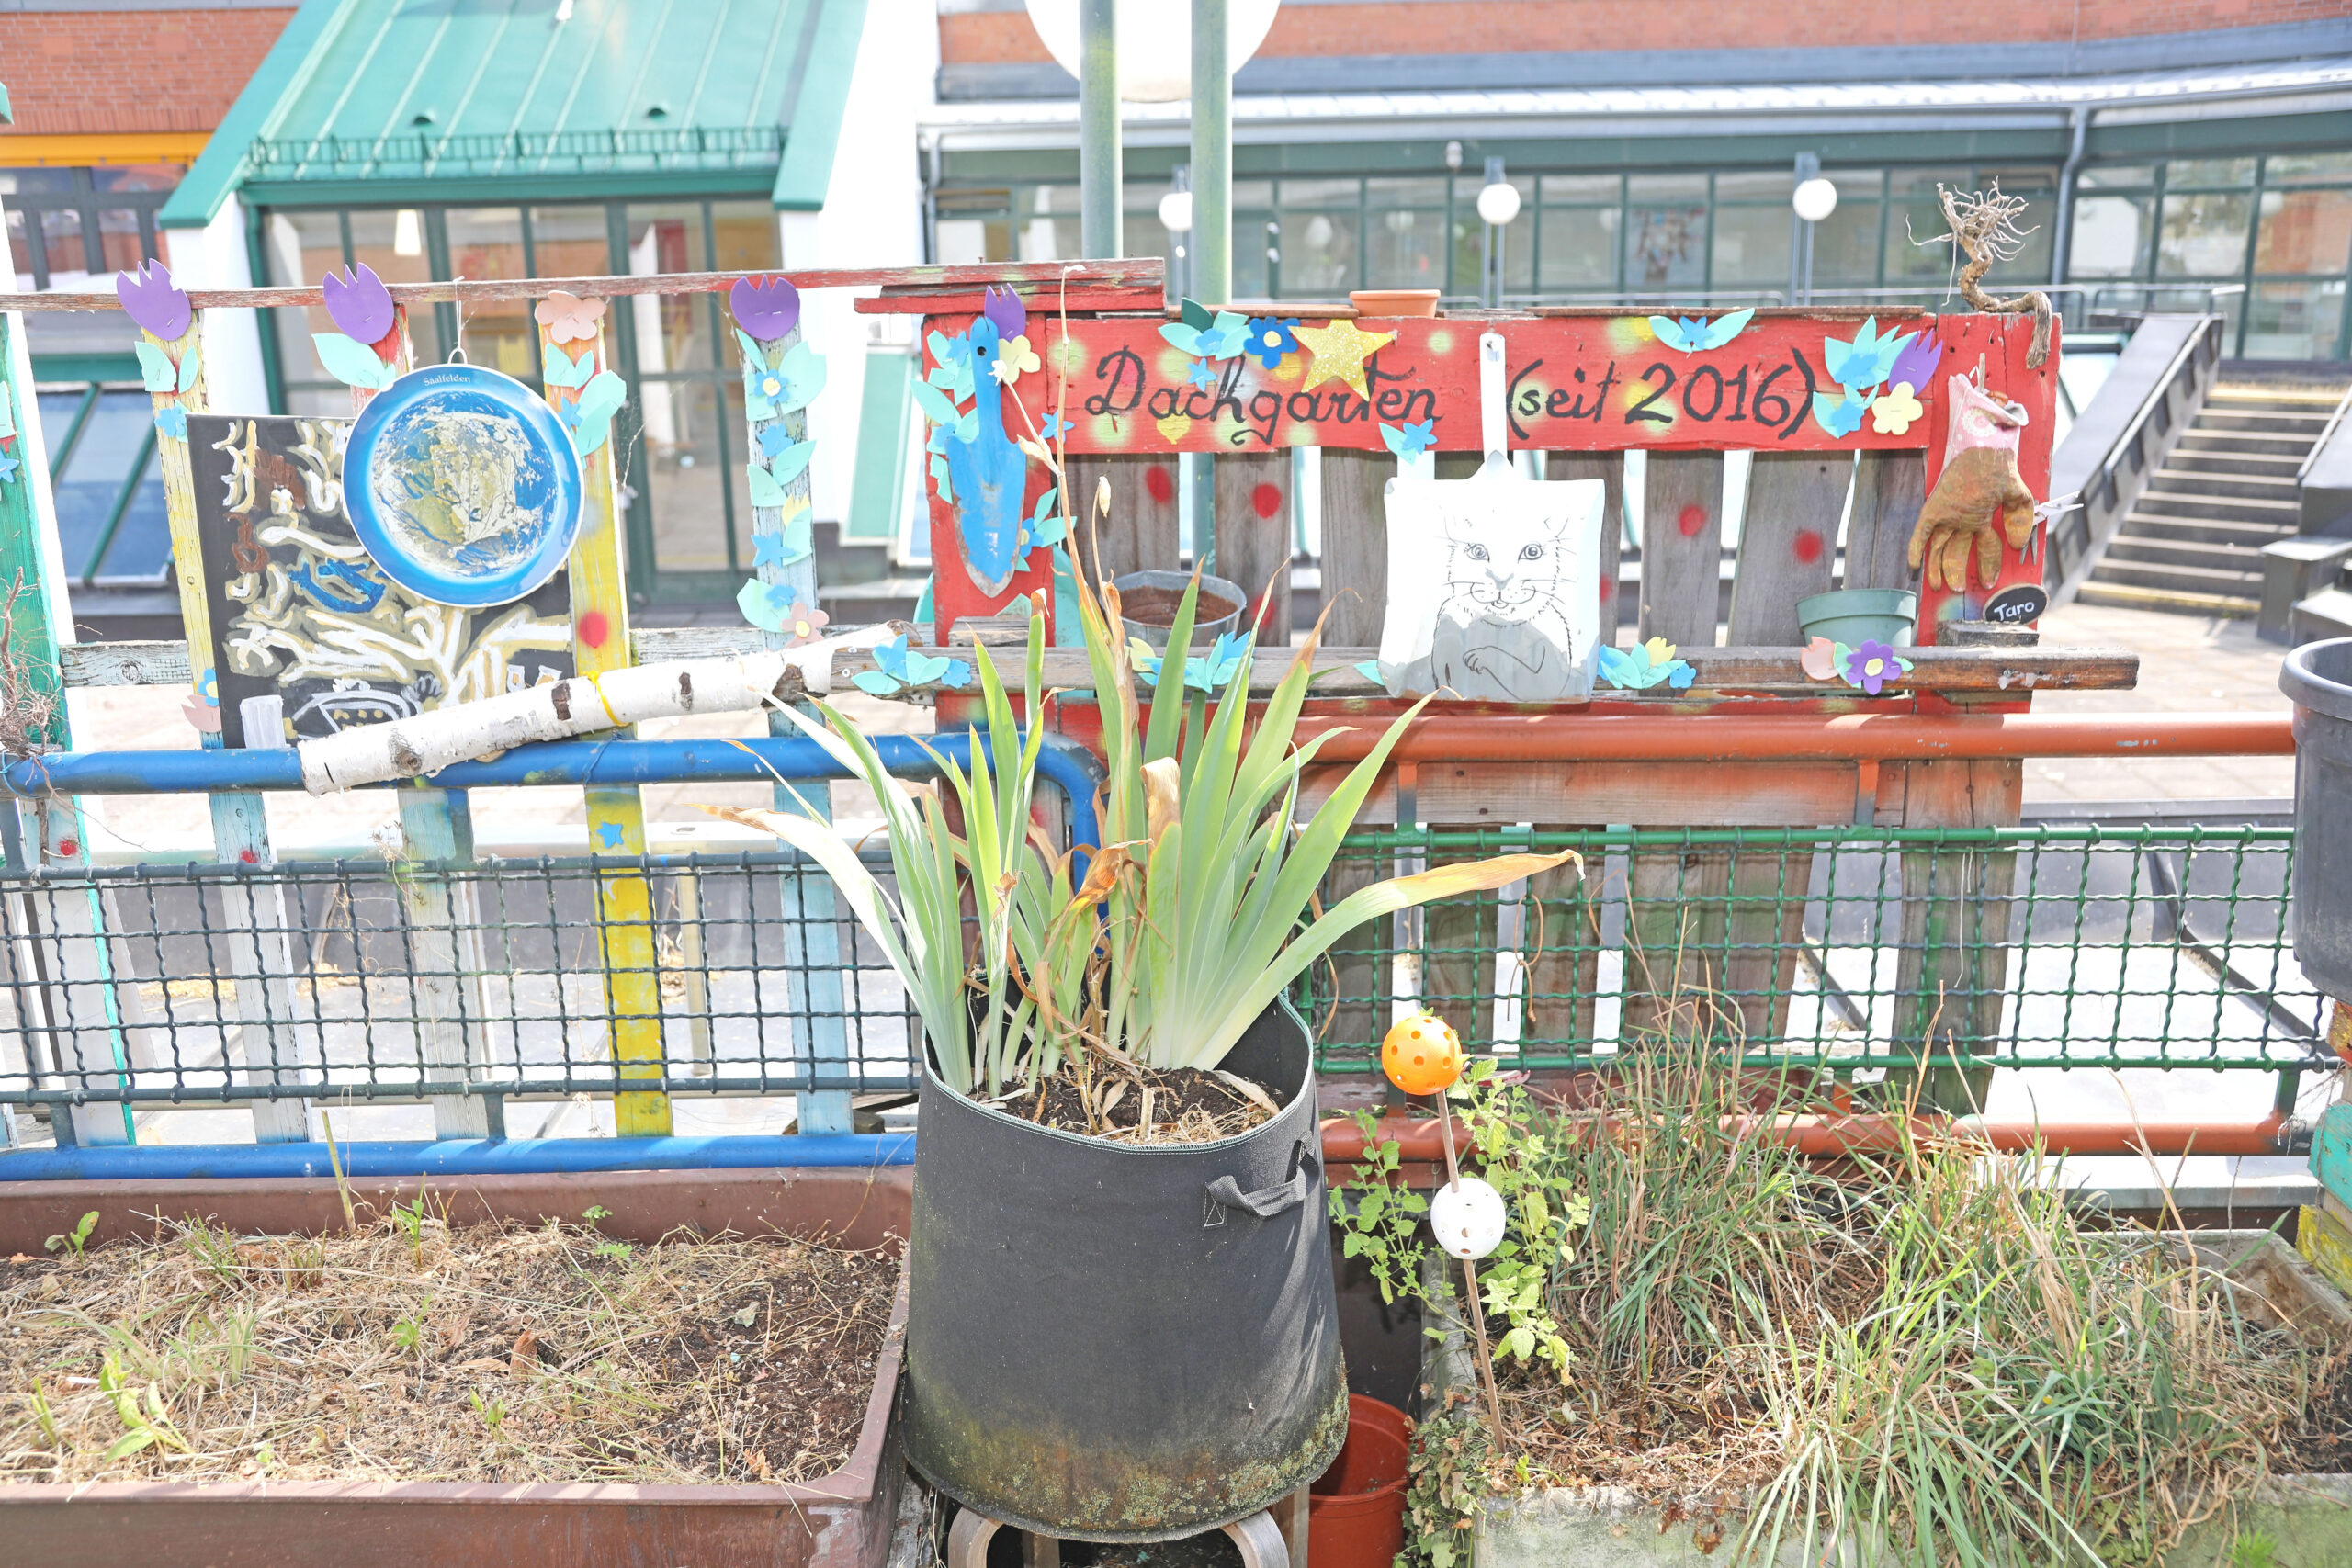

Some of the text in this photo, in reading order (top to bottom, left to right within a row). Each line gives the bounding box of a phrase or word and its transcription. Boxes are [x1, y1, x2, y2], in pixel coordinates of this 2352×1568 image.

[424, 374, 470, 386] Saalfelden
[1085, 344, 1816, 446] Dachgarten (seit 2016)
[1995, 602, 2034, 621] Taro
